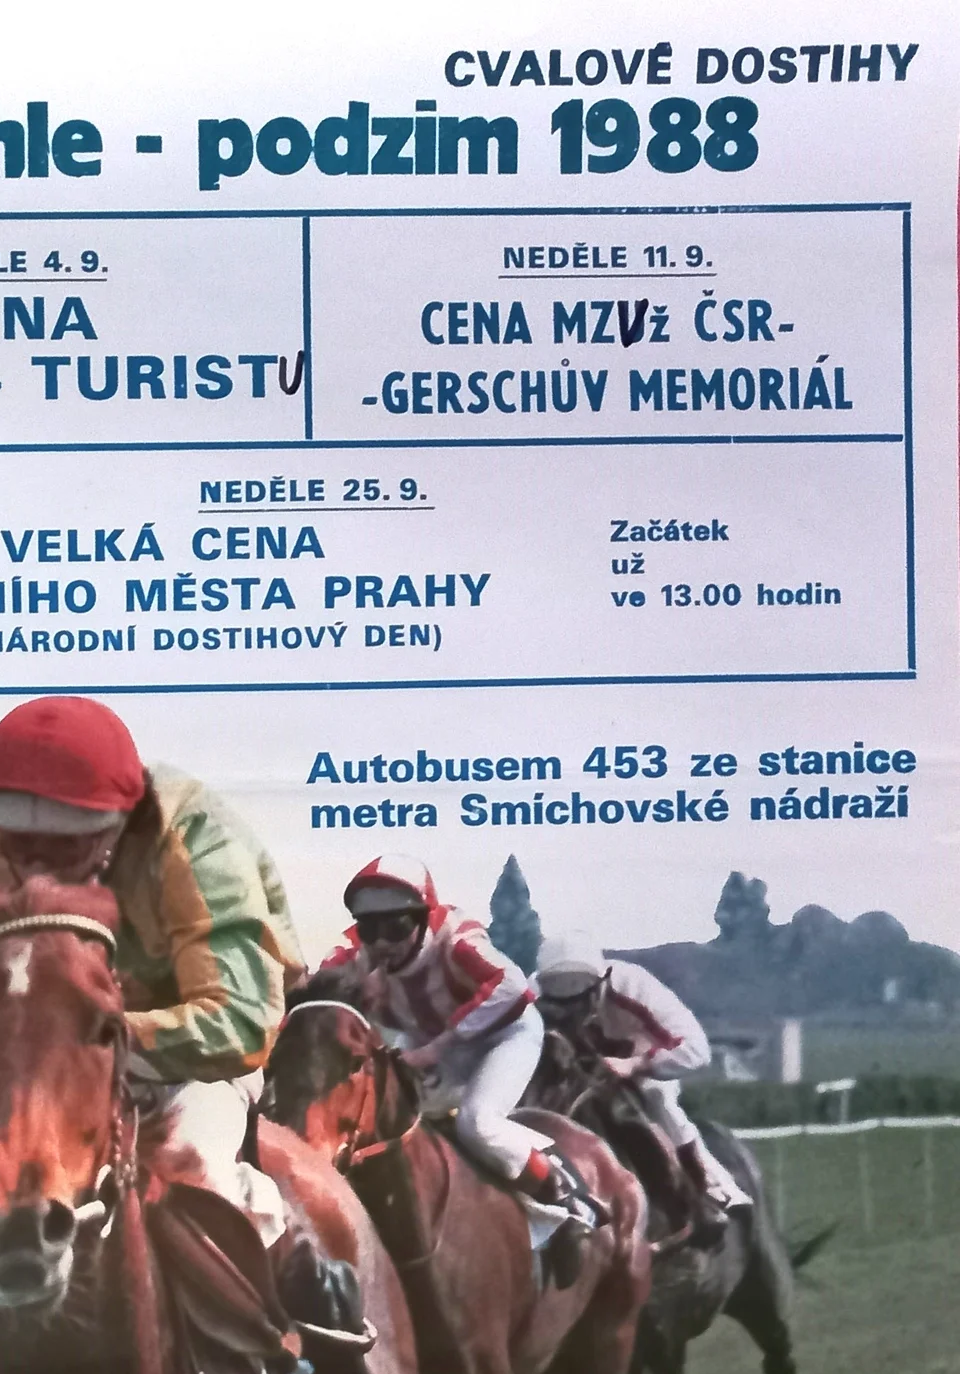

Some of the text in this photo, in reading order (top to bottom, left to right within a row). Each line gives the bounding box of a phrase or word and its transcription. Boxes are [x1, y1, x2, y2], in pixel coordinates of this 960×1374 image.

[444, 41, 920, 88] CVALOVÉ DOSTIHY
[197, 99, 519, 192] podzim
[550, 95, 759, 175] 1988
[503, 242, 628, 269] NEDĚLE
[421, 301, 533, 346] CENA
[694, 289, 795, 343] ČSR-
[31, 345, 313, 406] TURISTU
[628, 354, 853, 412] MEMORIÁL
[200, 475, 325, 504] NEDĚLE
[0, 522, 326, 563] VELKÁ CENA
[610, 518, 730, 543] Začátek
[611, 552, 645, 575] už
[125, 572, 296, 613] MĚSTA
[324, 573, 491, 609] PRAHY
[610, 582, 842, 608] ve 13.00 hodin
[153, 621, 348, 651] DOSTIHOVÝ
[364, 624, 442, 652] DEN)
[306, 741, 917, 785] Autobusem 453 ze stanice
[311, 785, 909, 829] metra Smíchovské nádraží
